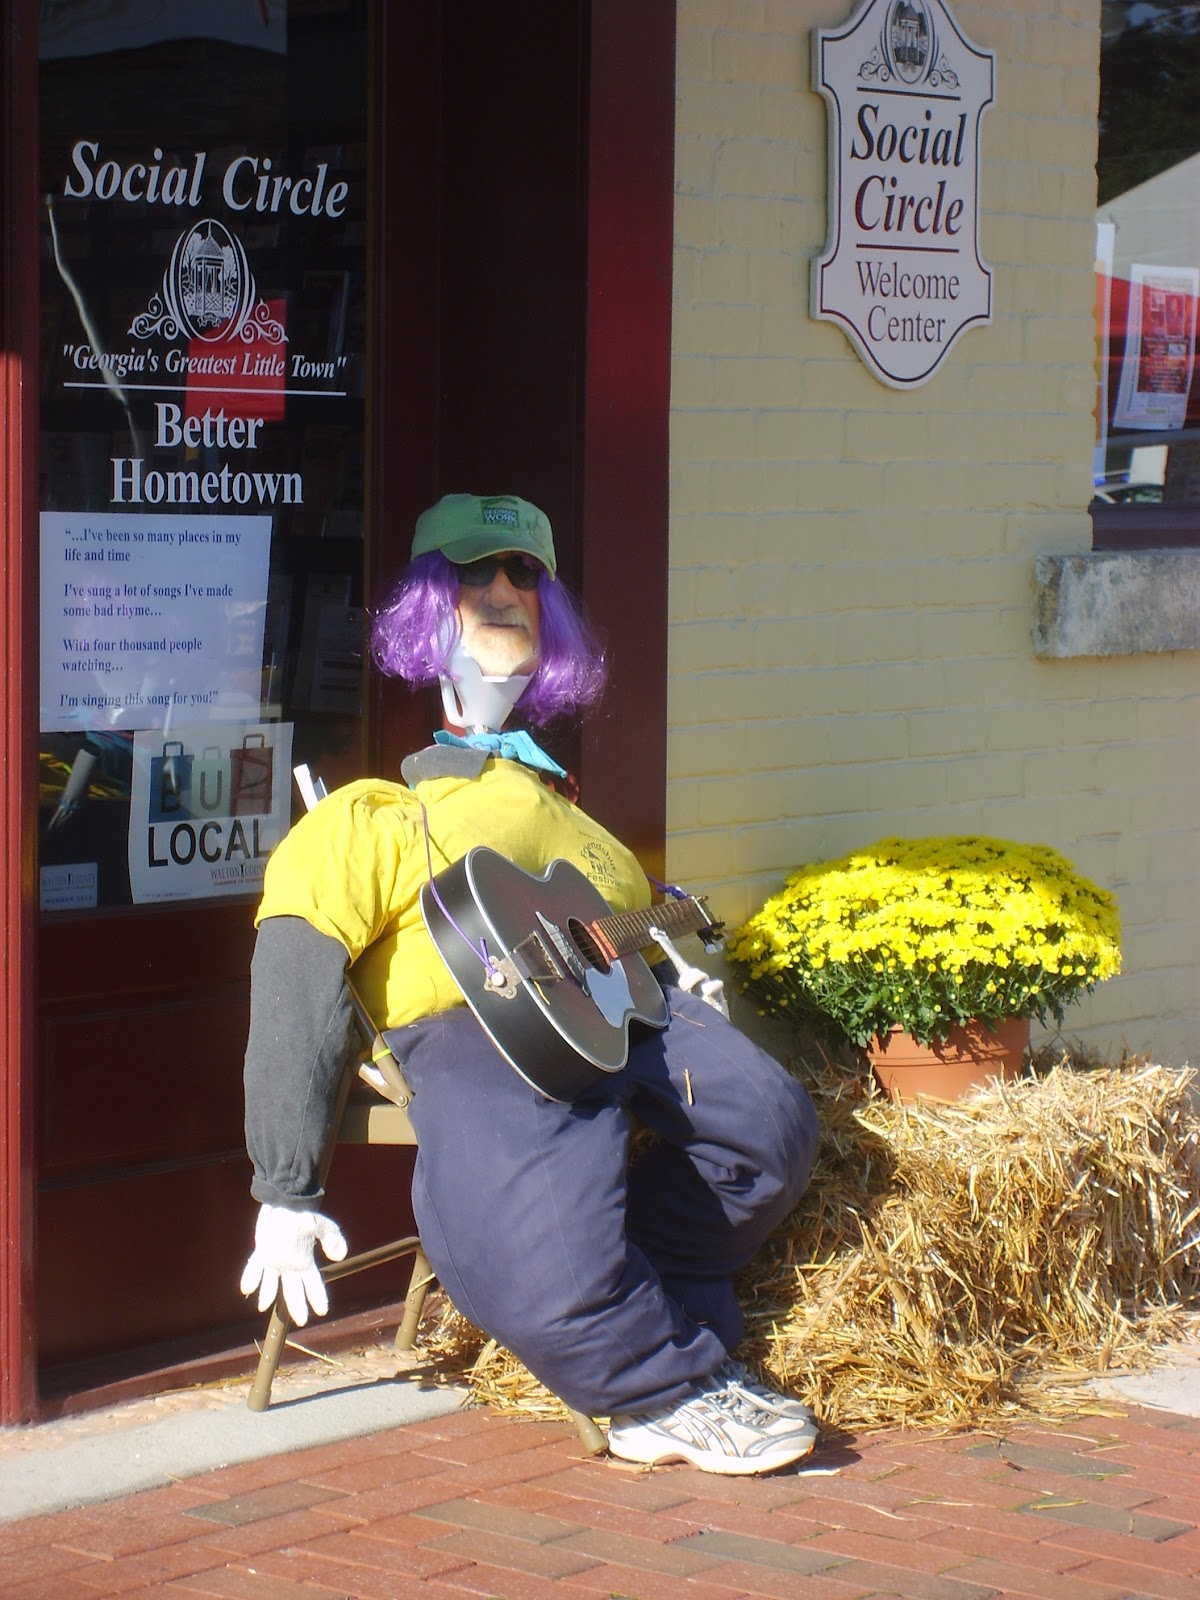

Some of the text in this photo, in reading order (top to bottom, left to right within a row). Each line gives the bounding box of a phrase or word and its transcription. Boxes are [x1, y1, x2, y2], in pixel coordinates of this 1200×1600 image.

[851, 103, 967, 167] Social
[64, 140, 349, 218] Social Circle
[855, 175, 964, 235] Circle
[856, 261, 960, 300] Welcome
[867, 305, 946, 343] Center
[63, 345, 347, 379] "Georgia's Greatest Little Town"
[154, 402, 264, 449] Better
[110, 457, 304, 505] Hometown
[485, 513, 517, 523] WORK
[106, 529, 130, 542] been
[133, 532, 144, 542] so
[147, 532, 175, 546] many
[178, 530, 209, 546] places
[212, 530, 222, 543] in
[226, 533, 241, 546] my
[64, 548, 131, 562] life and time
[64, 584, 234, 600] I've sung a lot of songs I've made
[63, 604, 162, 619] some bad rhyme...
[63, 637, 203, 655] With four thousand people
[62, 658, 123, 675] watching...
[60, 694, 79, 708] I'm
[81, 693, 121, 710] singing
[124, 692, 144, 706] this
[146, 694, 171, 708] song
[173, 691, 188, 705] for
[148, 819, 273, 868] LOCAL
[210, 866, 241, 880] WALTON
